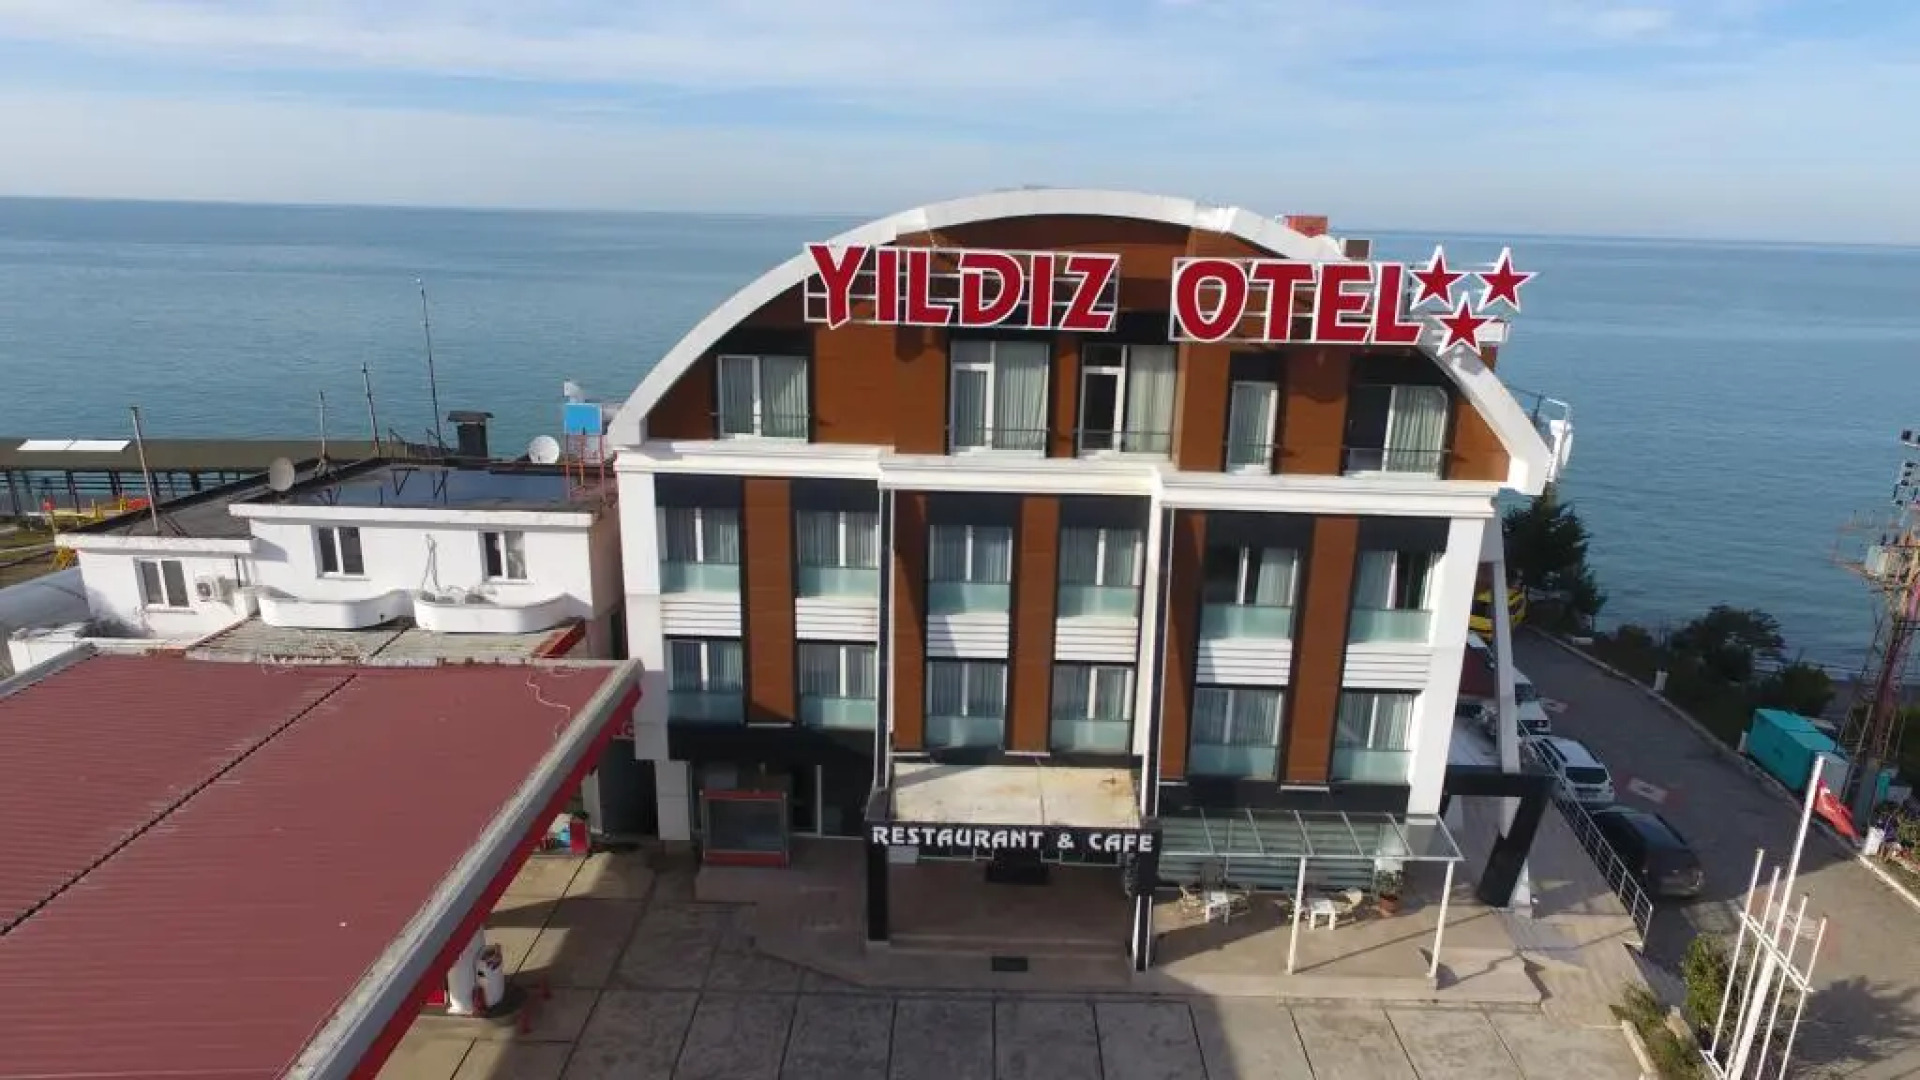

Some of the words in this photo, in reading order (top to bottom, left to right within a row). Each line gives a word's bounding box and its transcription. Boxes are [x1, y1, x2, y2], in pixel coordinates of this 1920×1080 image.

[808, 244, 1120, 331] YILDIZ
[1175, 258, 1424, 345] OTEL
[872, 826, 1044, 849] RESTAURANT
[1057, 832, 1075, 849] &
[1088, 833, 1153, 852] CAFE
